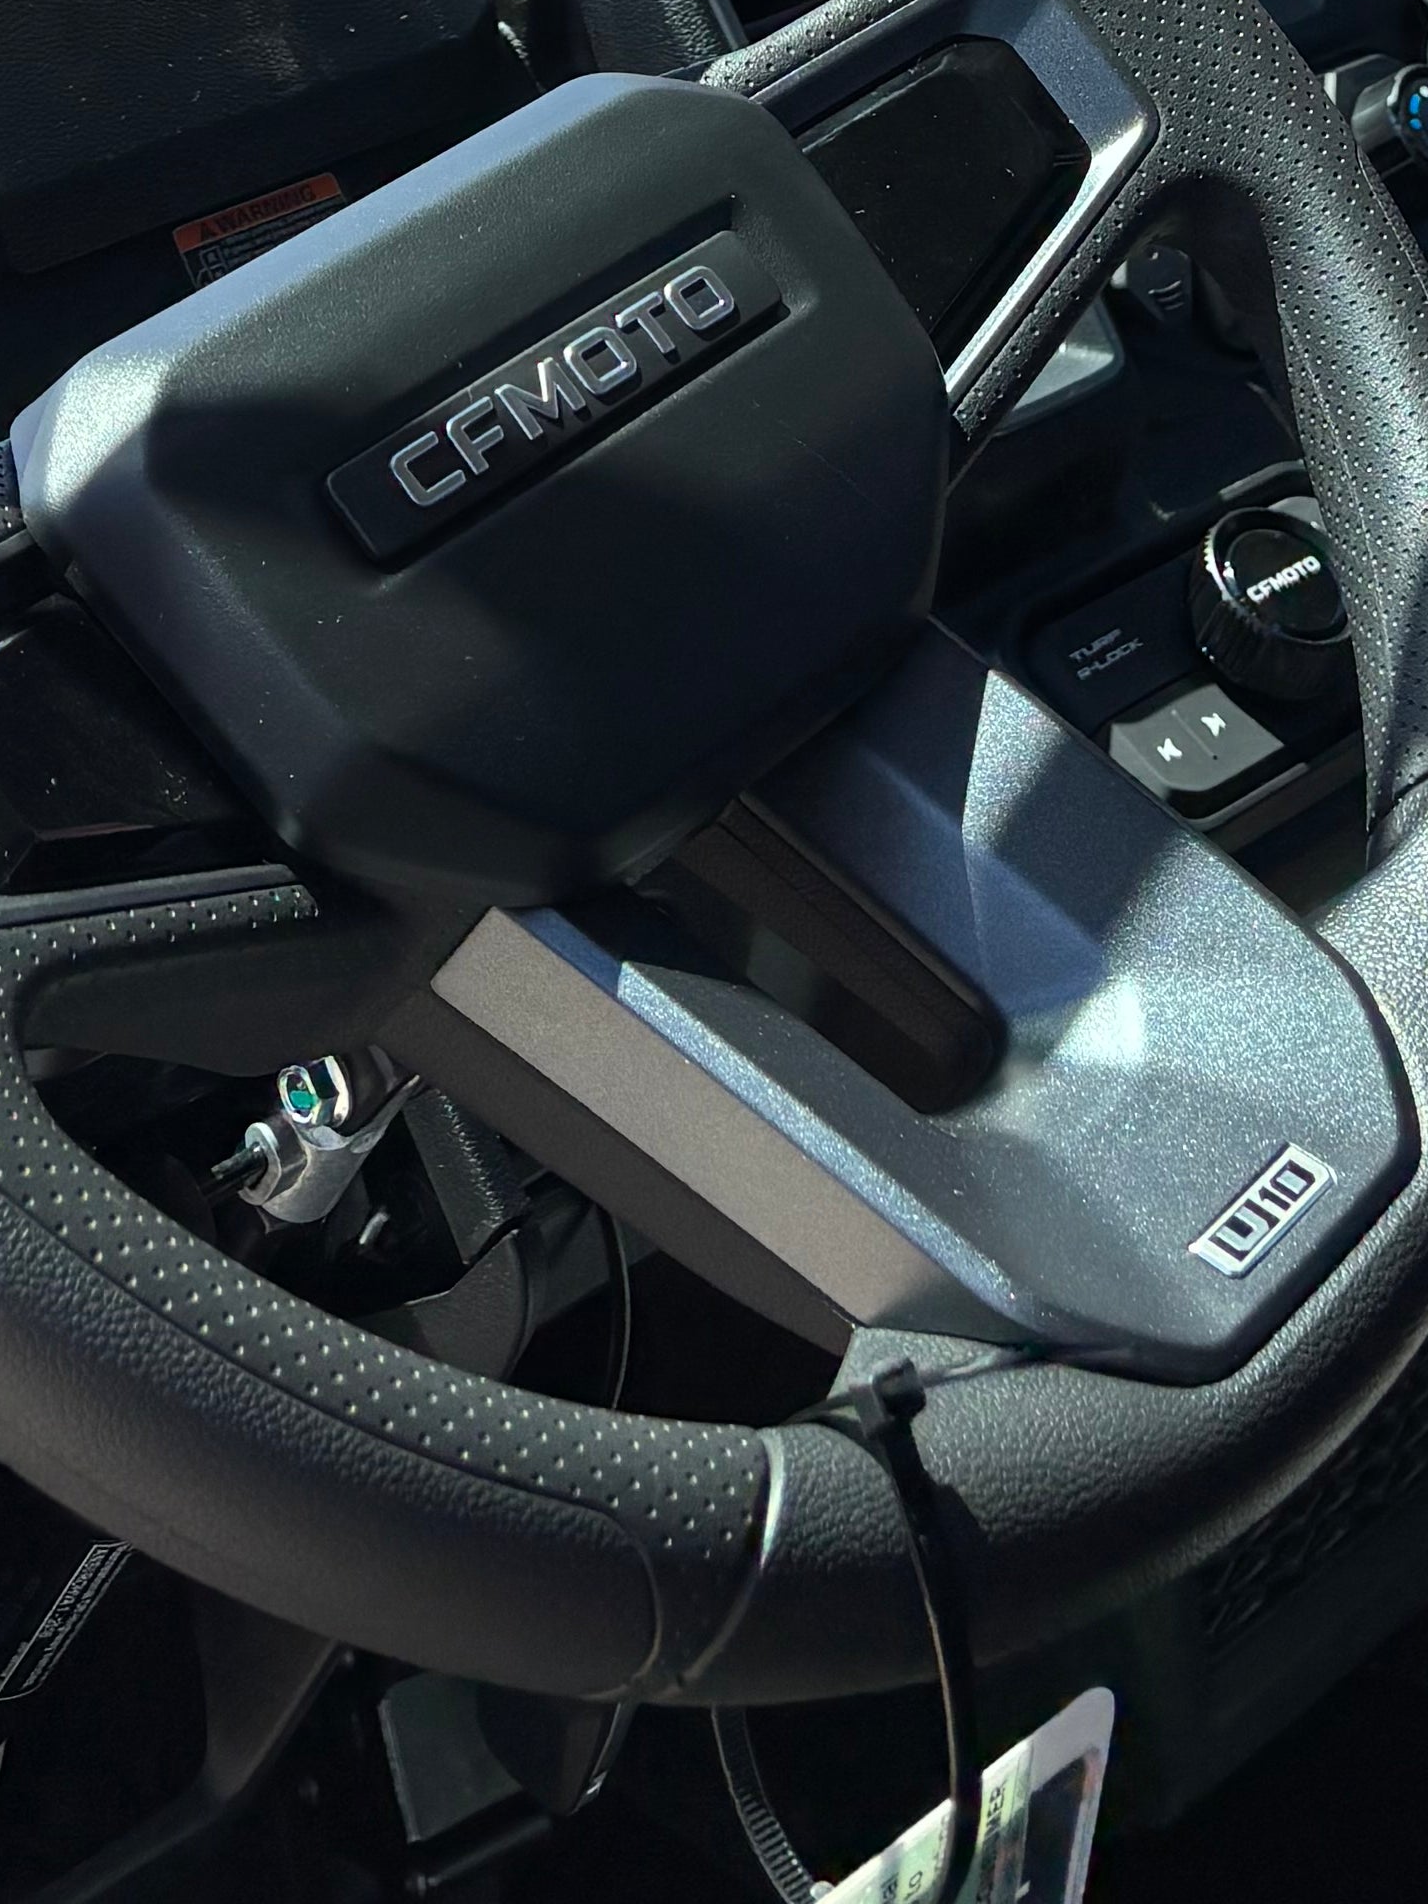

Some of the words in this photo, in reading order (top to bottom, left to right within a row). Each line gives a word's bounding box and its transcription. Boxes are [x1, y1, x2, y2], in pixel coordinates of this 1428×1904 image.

[388, 265, 737, 508] CFMOTO
[1245, 554, 1323, 605] CFMOTO
[1207, 1159, 1316, 1263] U10
